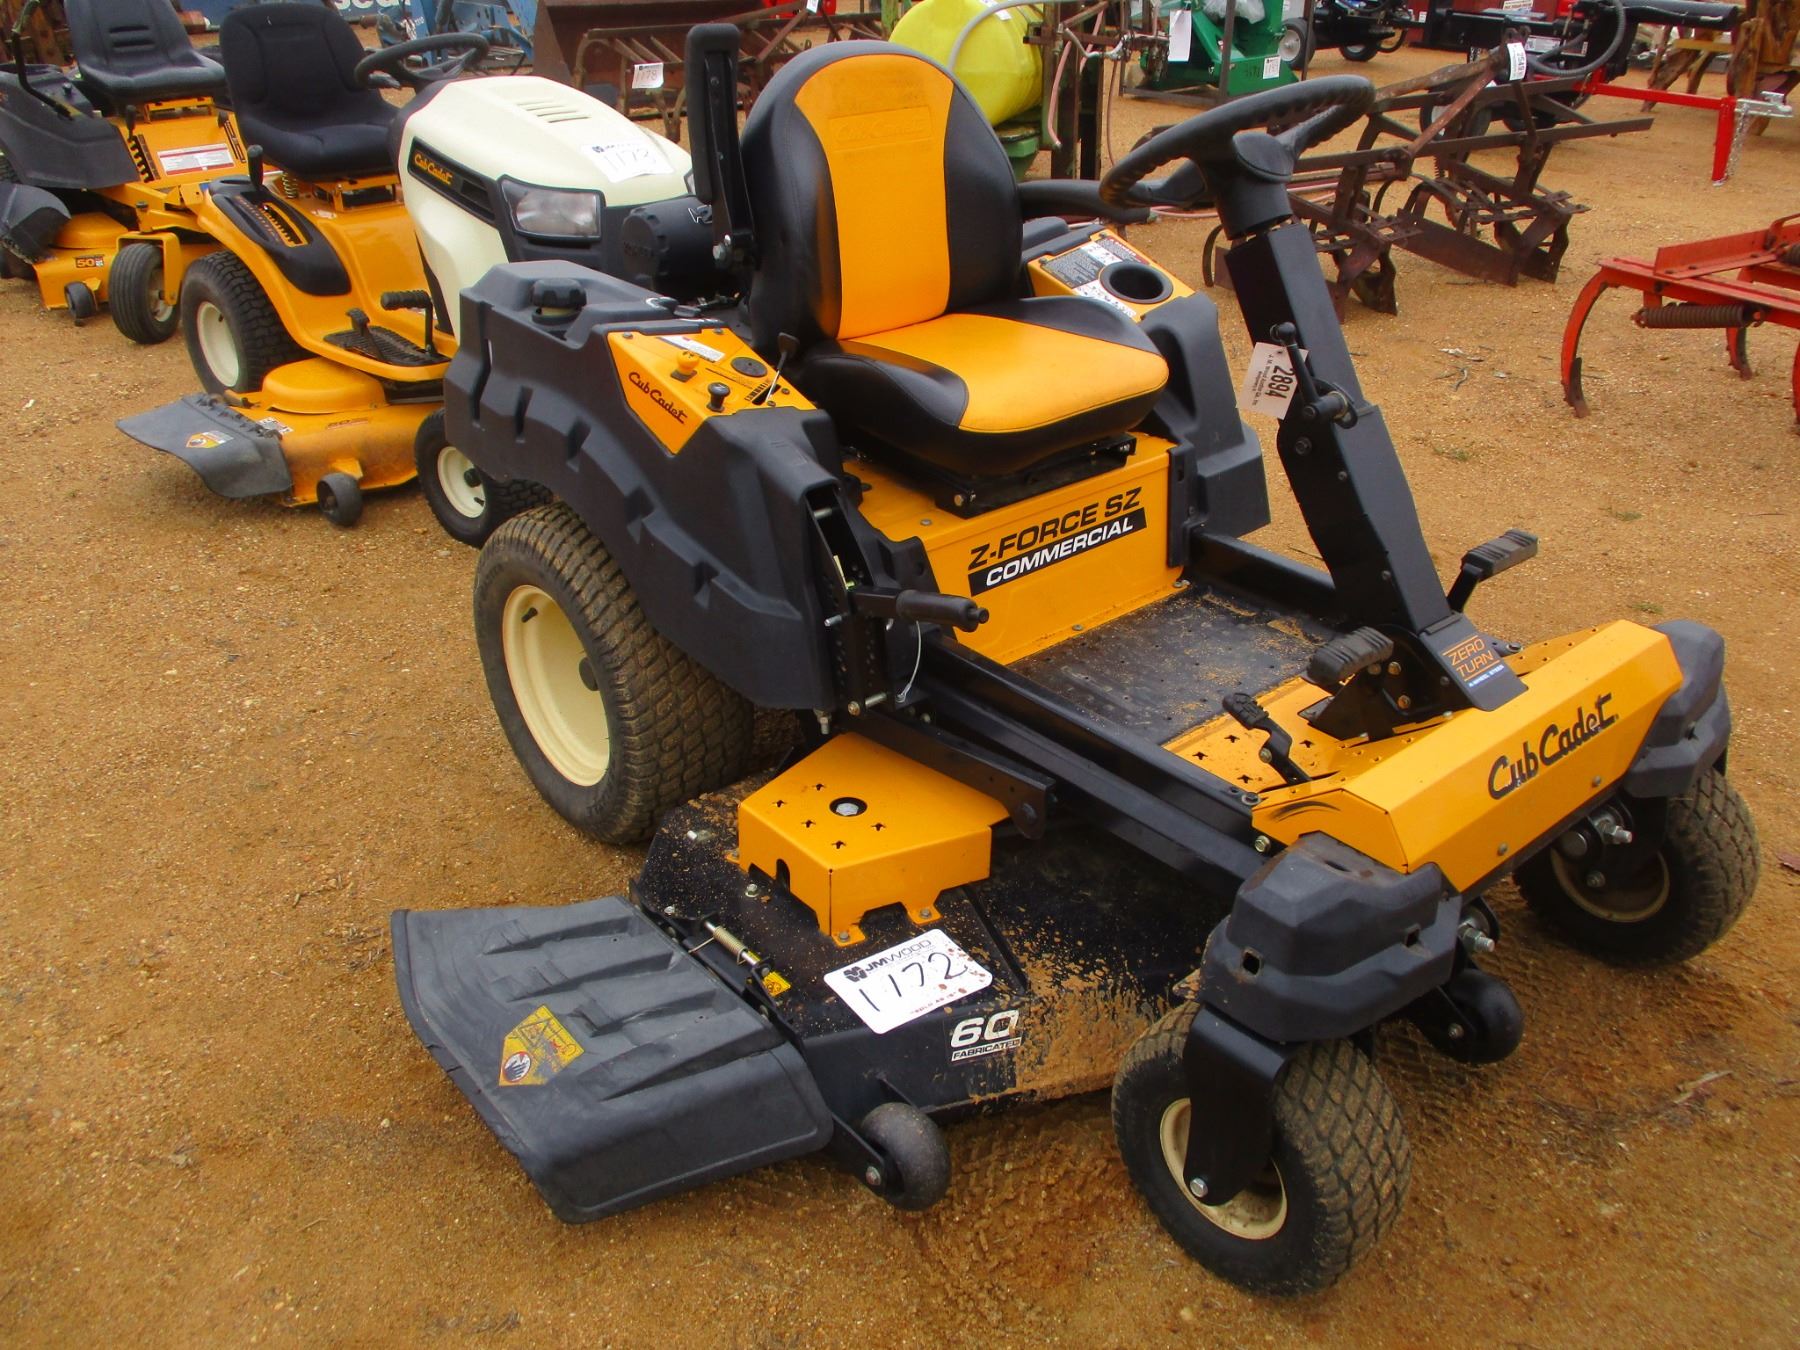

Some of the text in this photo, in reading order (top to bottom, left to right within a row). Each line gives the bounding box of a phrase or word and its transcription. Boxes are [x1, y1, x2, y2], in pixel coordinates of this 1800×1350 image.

[77, 258, 96, 267] 50
[629, 372, 688, 424] Cub Cadet
[1265, 365, 1296, 399] 2894
[968, 486, 1143, 571] Z-FORCE SZ
[986, 517, 1134, 587] COMMERCIAL
[1448, 638, 1486, 666] ZERO
[1456, 650, 1494, 677] TURN
[1488, 692, 1616, 800] Cub Cadet
[858, 952, 969, 1013] 1172
[951, 1009, 1020, 1048] 60
[953, 1038, 1021, 1060] FABRICATED
